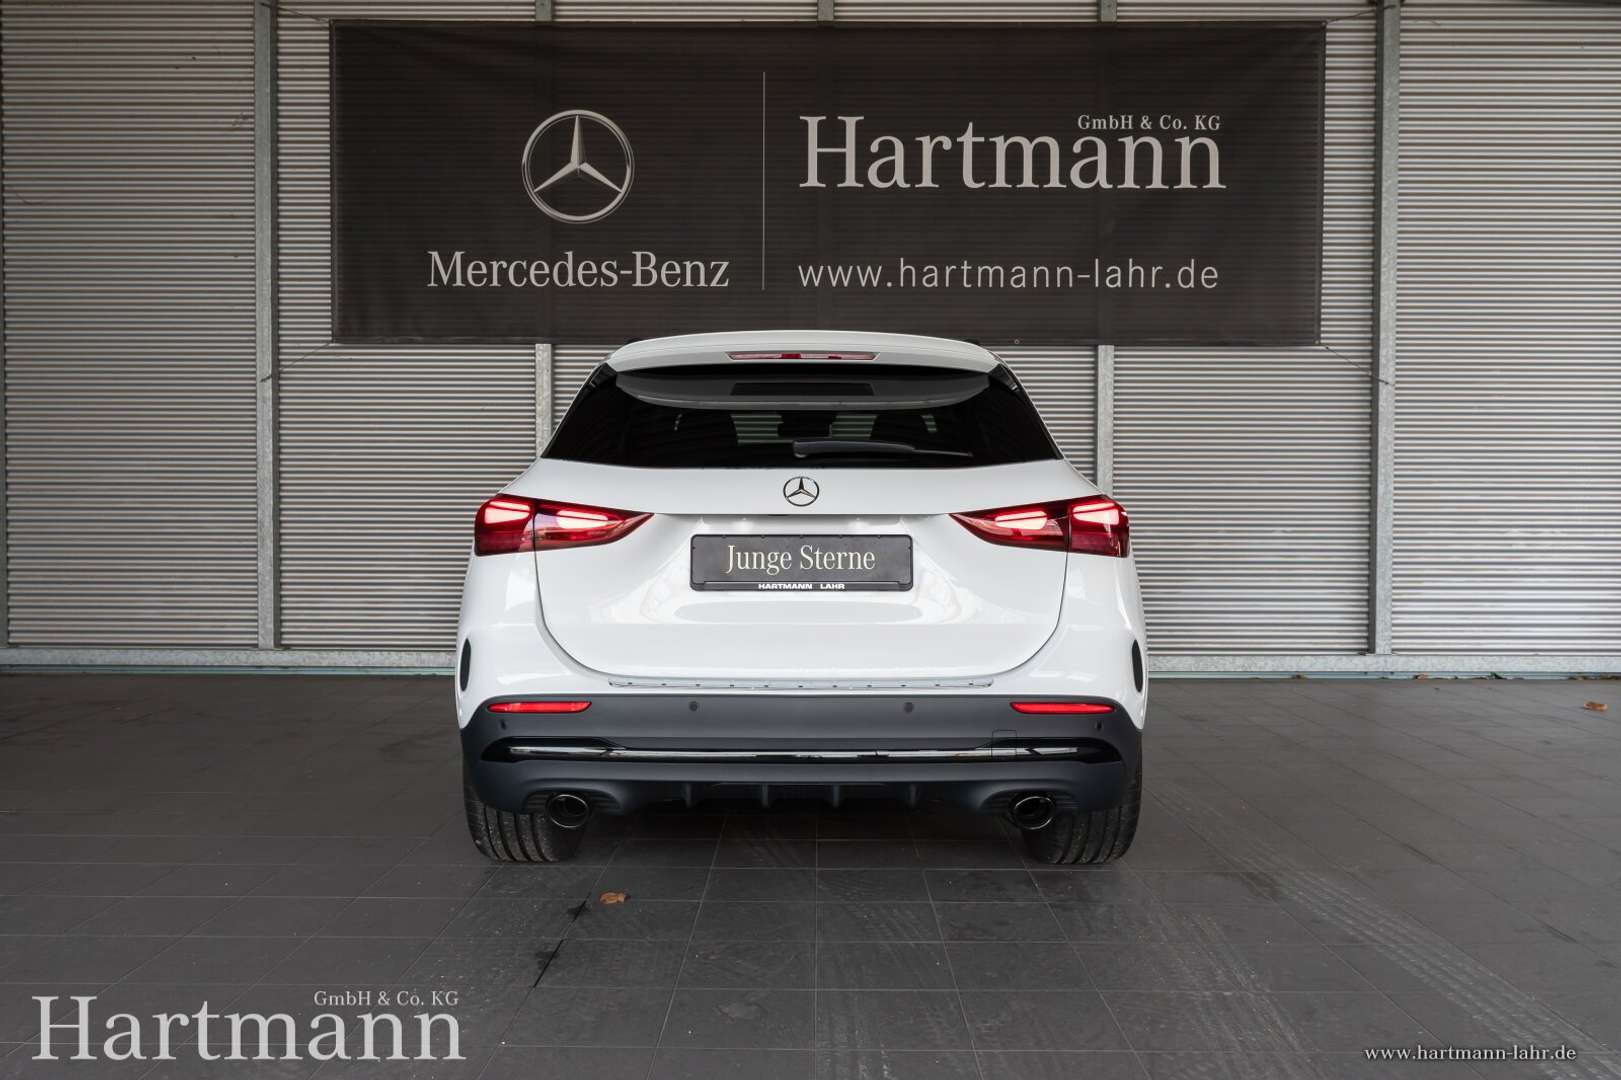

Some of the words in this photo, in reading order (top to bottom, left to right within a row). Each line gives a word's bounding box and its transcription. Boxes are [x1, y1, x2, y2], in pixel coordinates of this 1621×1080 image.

[1078, 115, 1133, 129] GmbH
[1140, 115, 1152, 129] &
[1159, 115, 1187, 130] Co.
[1195, 115, 1220, 130] KG
[799, 115, 1227, 189] Hartmann
[427, 250, 729, 288] Mercedes-Benz
[798, 258, 1218, 289] www.hartmann-lahr.de
[726, 545, 792, 575] Junge
[799, 544, 876, 570] Sterne
